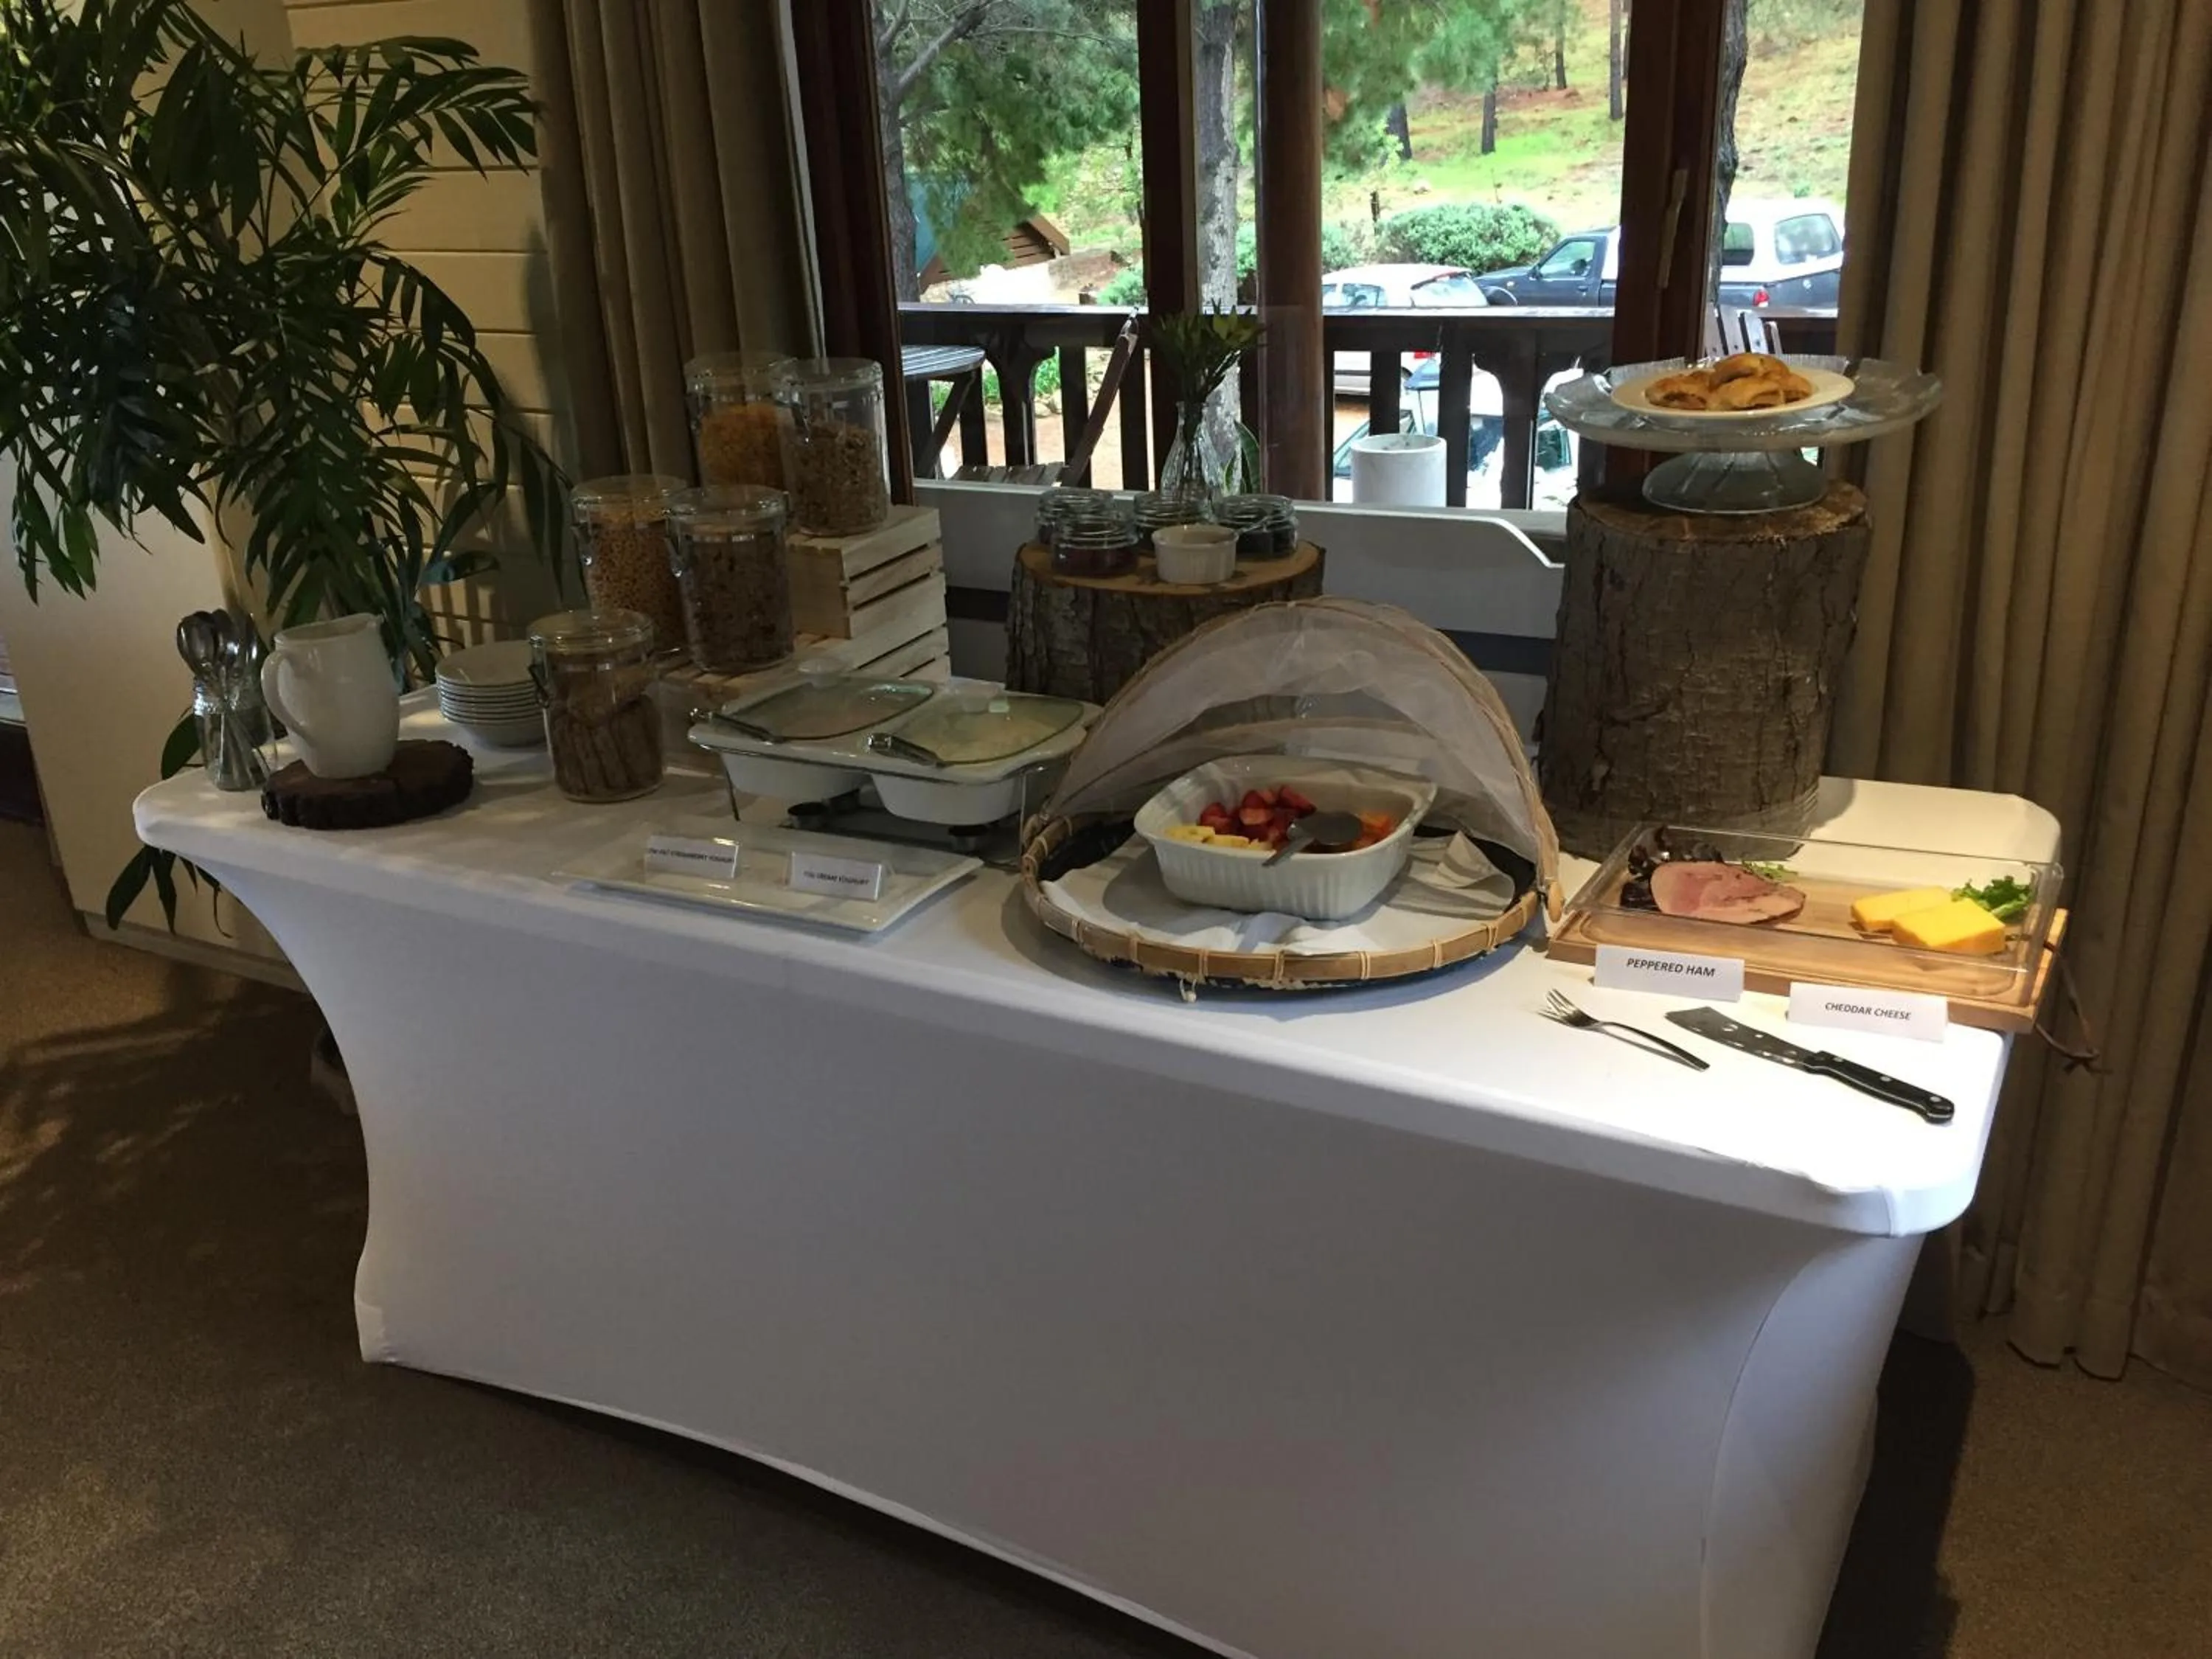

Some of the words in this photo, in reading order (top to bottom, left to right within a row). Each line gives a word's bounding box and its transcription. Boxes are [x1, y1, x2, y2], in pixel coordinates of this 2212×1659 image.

[1626, 958, 1683, 973] PEPPERED
[1686, 964, 1717, 977] HAM
[1824, 1002, 1873, 1015] CHEDDAR
[1874, 1008, 1912, 1020] CHEESE
